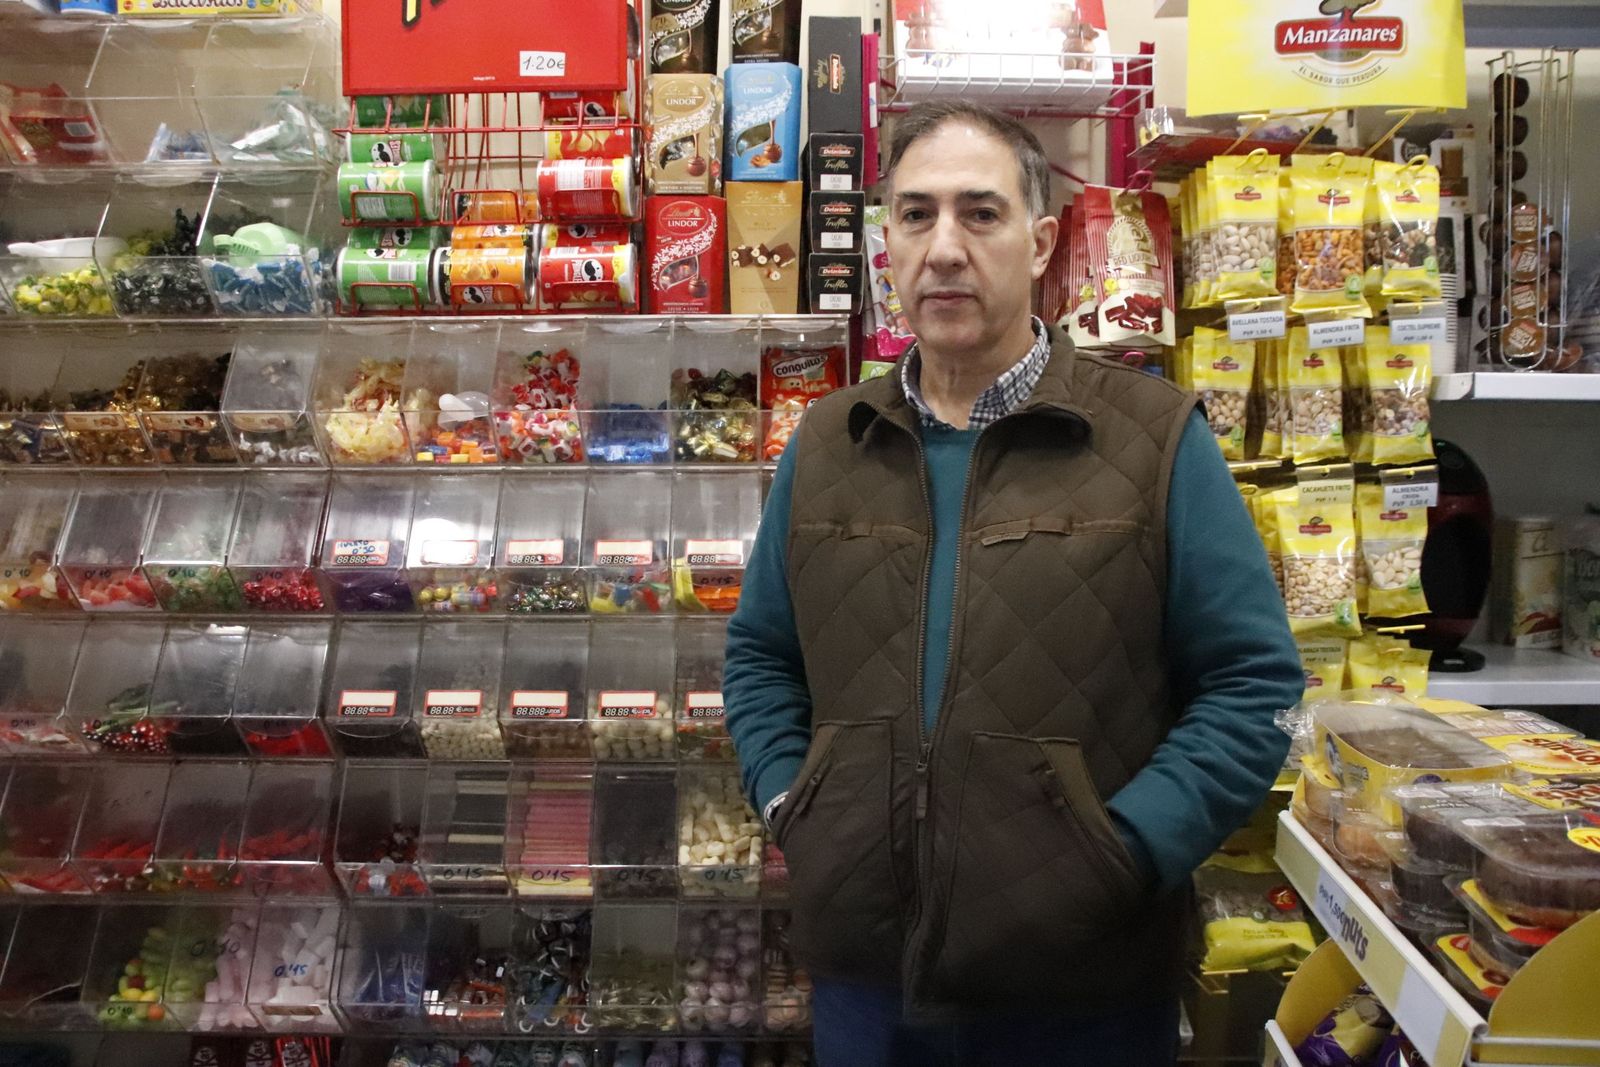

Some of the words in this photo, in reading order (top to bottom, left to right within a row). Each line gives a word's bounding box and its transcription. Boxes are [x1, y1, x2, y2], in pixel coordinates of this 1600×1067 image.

[1282, 25, 1399, 46] Manzanares
[1298, 65, 1307, 76] EL
[1309, 71, 1333, 84] SABOR
[1352, 65, 1383, 84] PERDURA
[743, 86, 774, 95] LINDOR
[666, 97, 698, 106] LINDOR
[667, 220, 698, 228] LINDOR
[775, 354, 829, 377] conguitos
[1392, 486, 1429, 494] ALMENDRA
[1522, 738, 1600, 767] onuts
[531, 869, 571, 881] 0'15
[1342, 916, 1369, 962] nuts
[274, 963, 309, 980] 0'15
